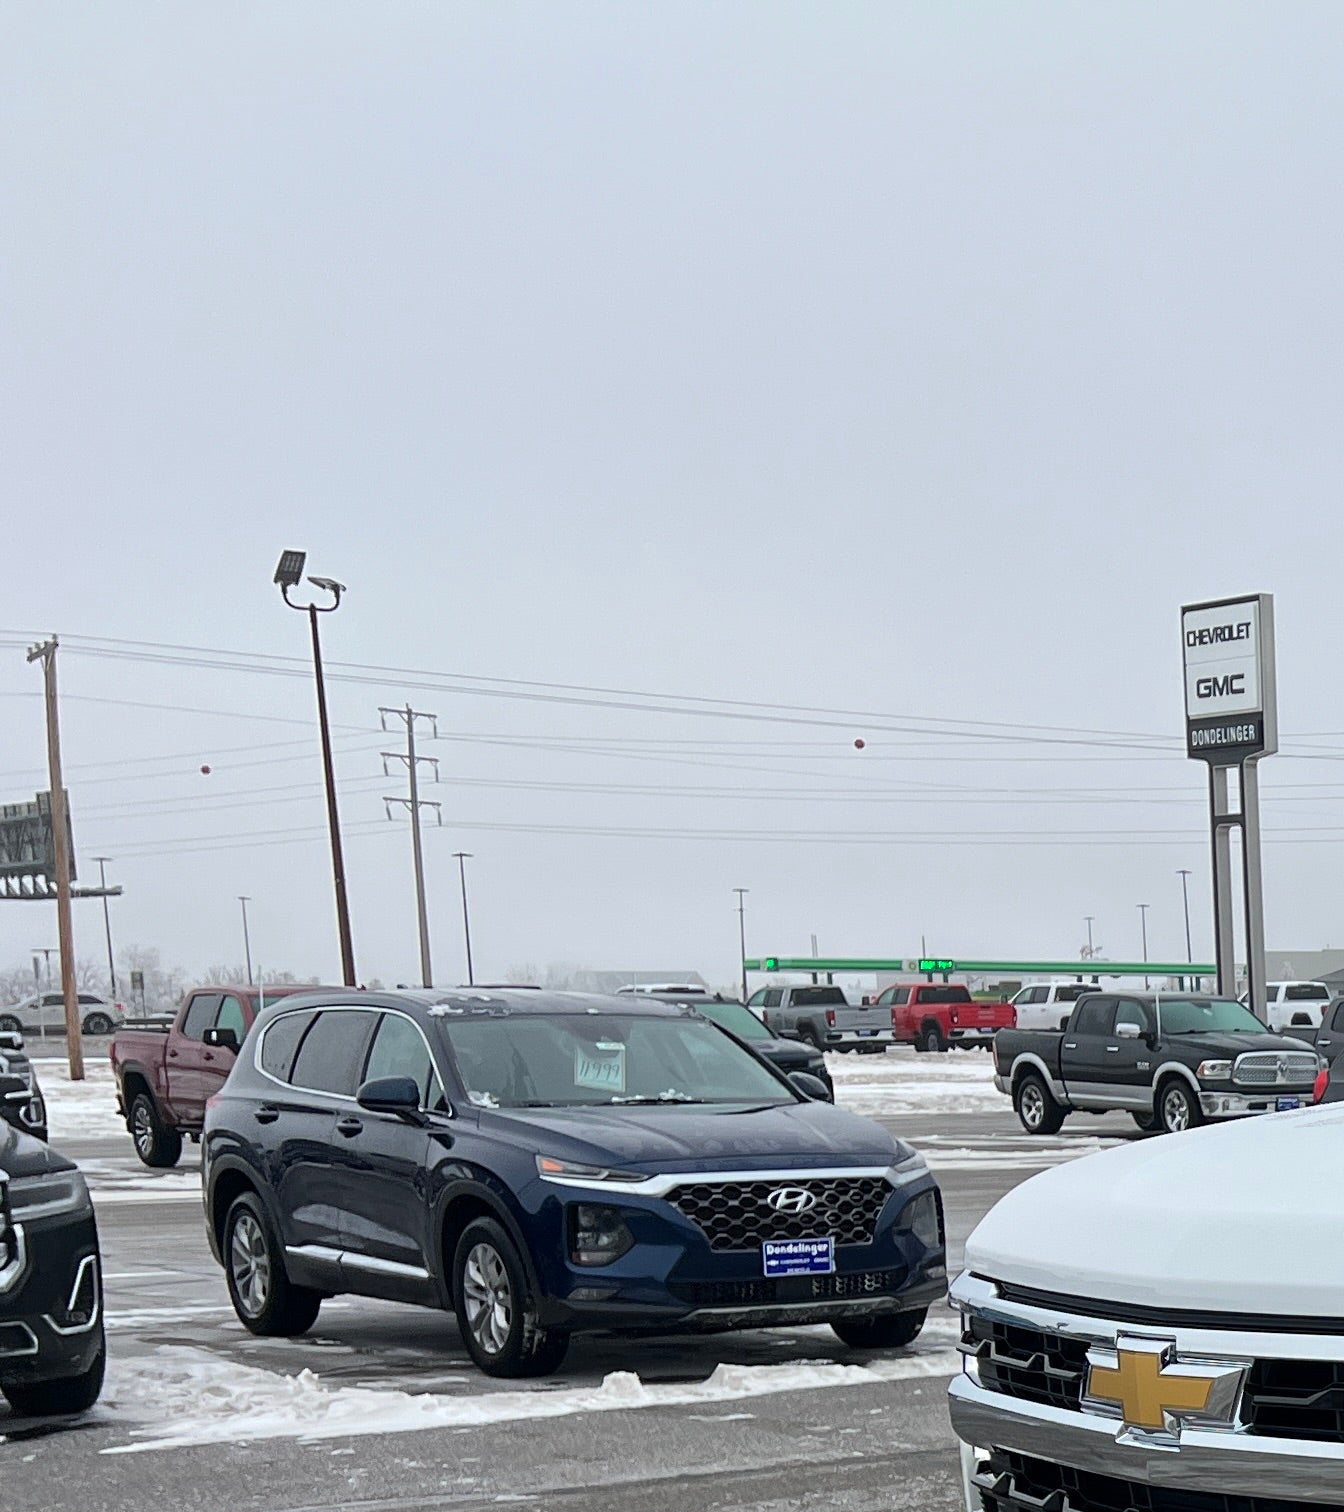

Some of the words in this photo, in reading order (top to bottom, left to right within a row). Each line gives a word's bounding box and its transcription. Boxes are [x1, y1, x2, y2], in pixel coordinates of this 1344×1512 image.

[1187, 622, 1251, 647] CHEVROLET
[1196, 673, 1245, 698] GMC
[1191, 724, 1256, 746] DONDELINGER
[766, 1243, 828, 1256] Dondelinger
